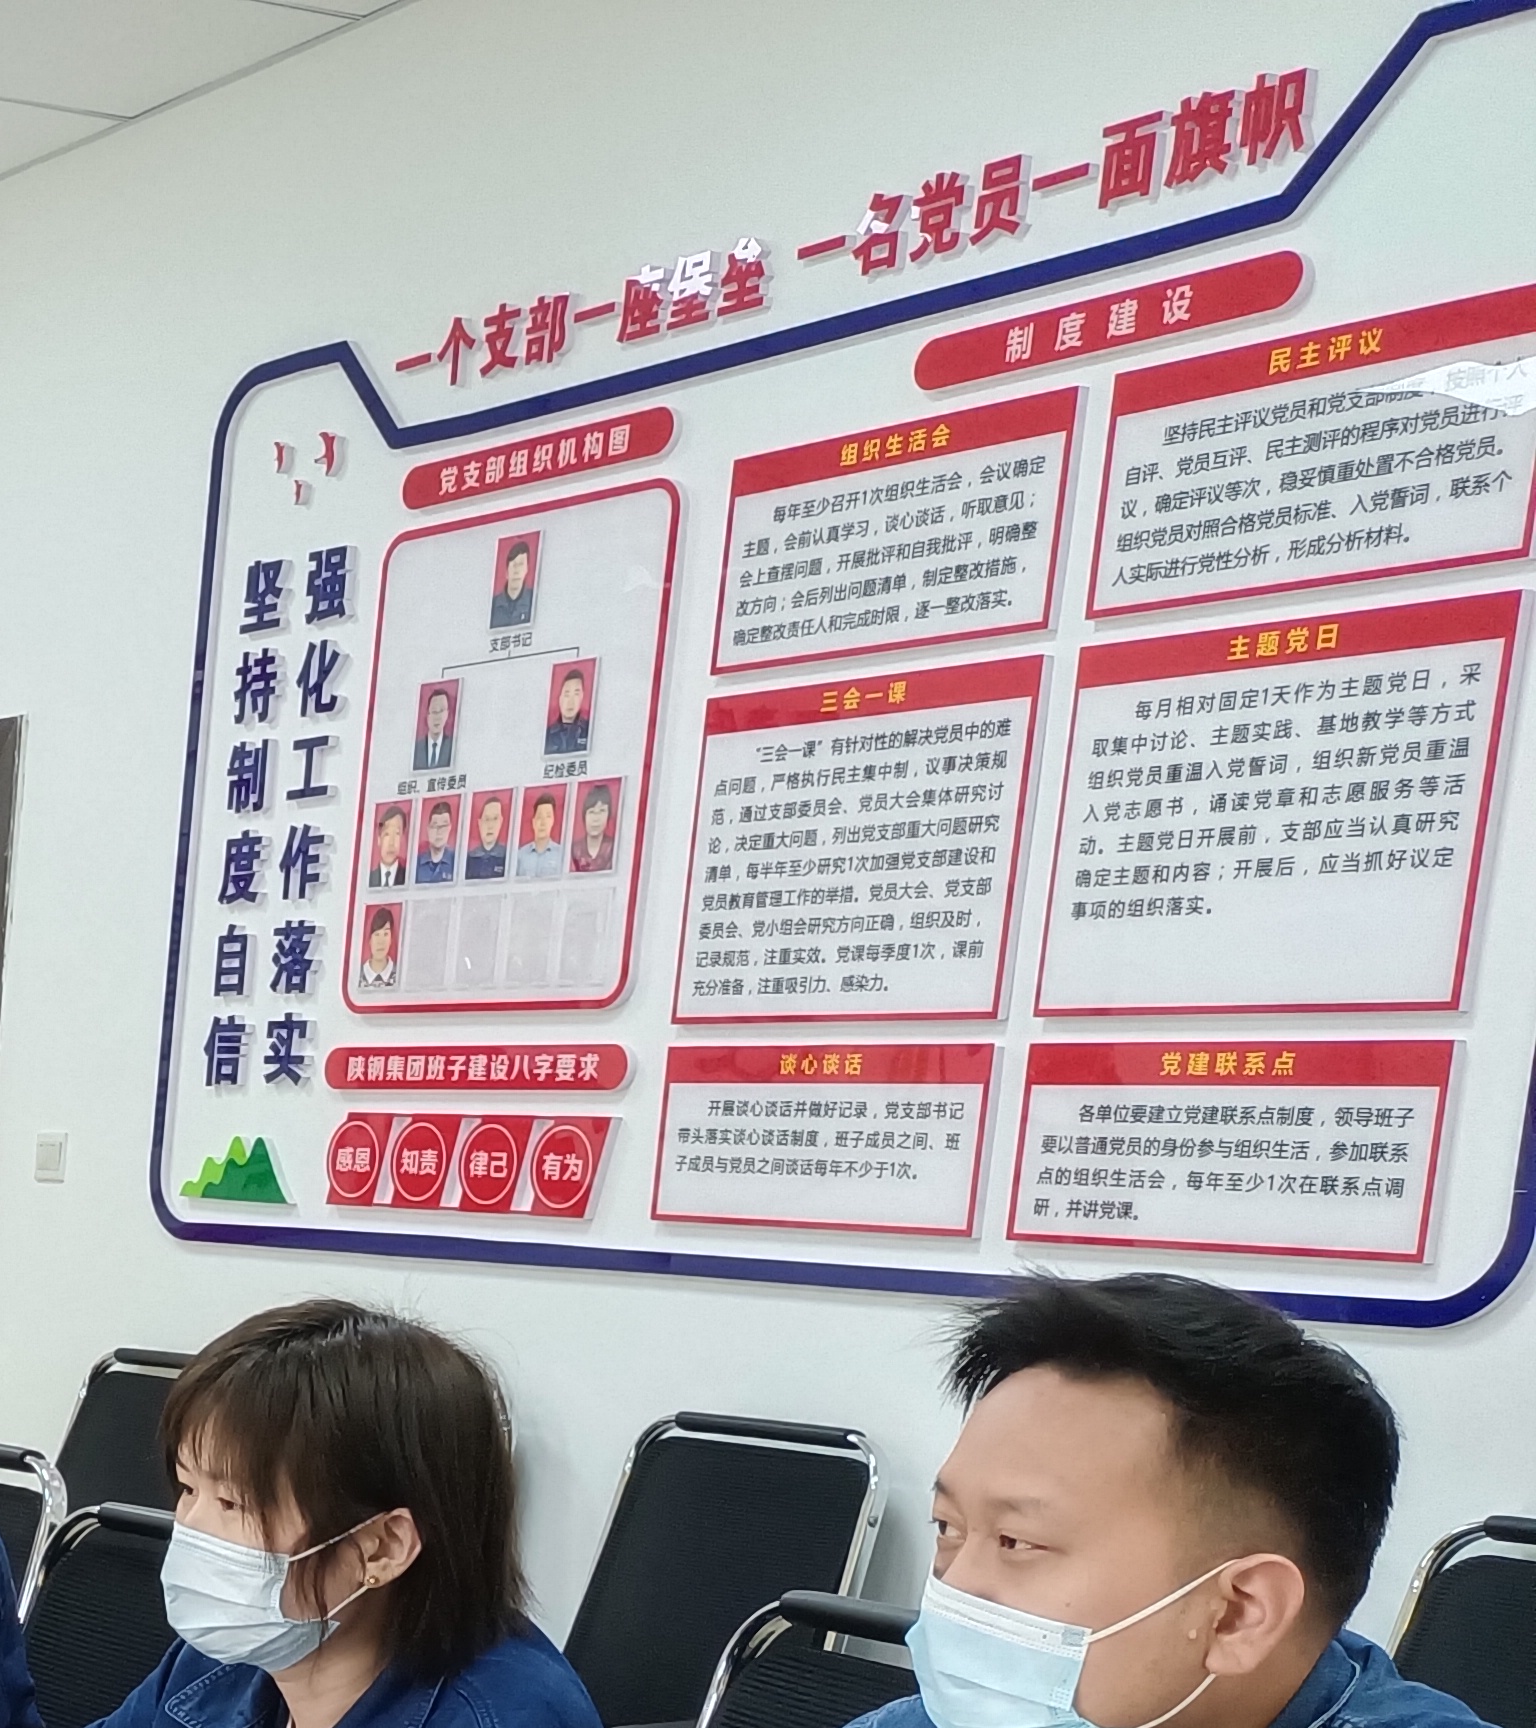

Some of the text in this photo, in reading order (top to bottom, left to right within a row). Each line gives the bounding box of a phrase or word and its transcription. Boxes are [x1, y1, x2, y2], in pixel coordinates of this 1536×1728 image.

[395, 67, 1312, 387] 一个支部一座堡垒 一名党员一面旗帜
[1005, 285, 1193, 363] 制度建设
[1267, 328, 1383, 375] 民主评议
[438, 424, 632, 497] 党支部组织机构图
[840, 424, 951, 467] 组织生活会
[489, 632, 532, 653] 支部书记
[1226, 623, 1339, 661] 主题党日
[820, 681, 907, 712] 三会一课
[543, 761, 587, 779] 纪检委员
[203, 558, 287, 1087] 坚持制度自信
[263, 545, 352, 1086] 强化工作落实
[347, 1053, 600, 1083] 陕钢集团班子建设八字要求
[779, 1053, 863, 1076] 谈心谈话
[1159, 1051, 1296, 1077] 党建联系点
[335, 1146, 581, 1182] 感恩 知责 律己 有为
